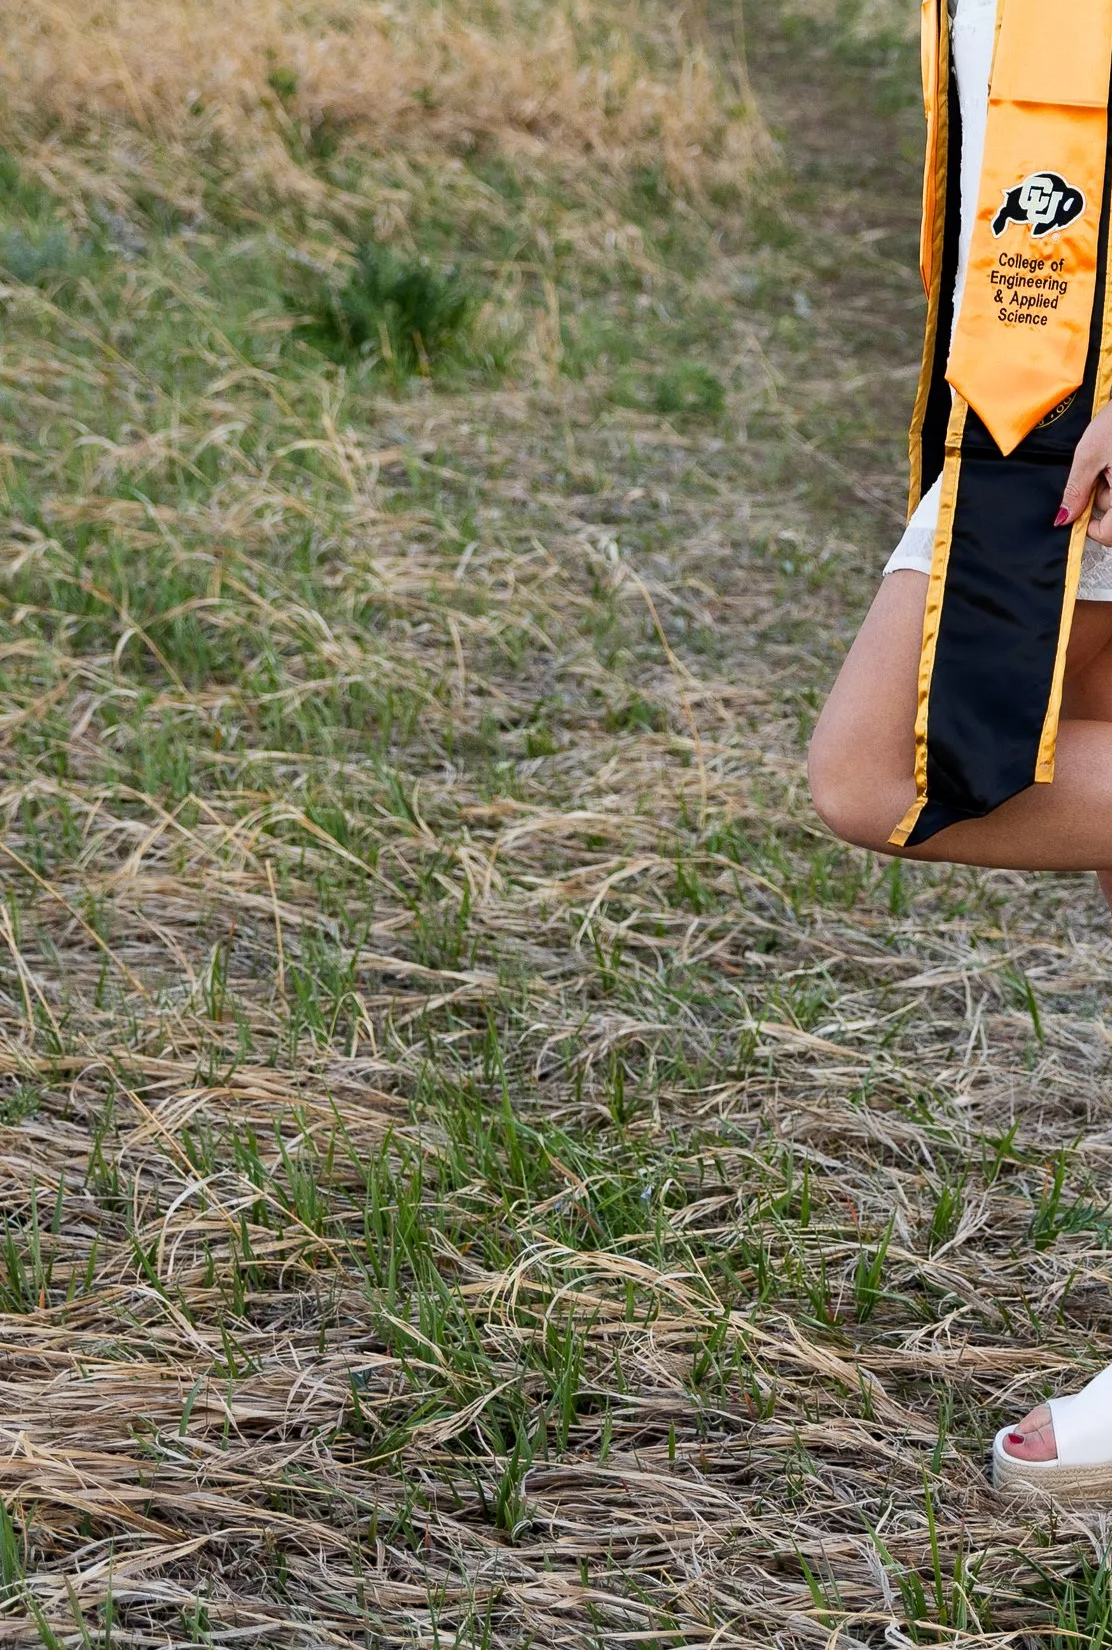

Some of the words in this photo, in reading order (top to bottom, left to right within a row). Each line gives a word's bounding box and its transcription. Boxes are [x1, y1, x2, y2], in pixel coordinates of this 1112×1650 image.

[1018, 176, 1063, 224] CU
[999, 252, 1045, 273] College
[1050, 258, 1065, 272] of
[990, 270, 1068, 294] Engineering
[994, 289, 1004, 303] &
[1009, 290, 1059, 309] Applied
[997, 308, 1048, 325] Science
